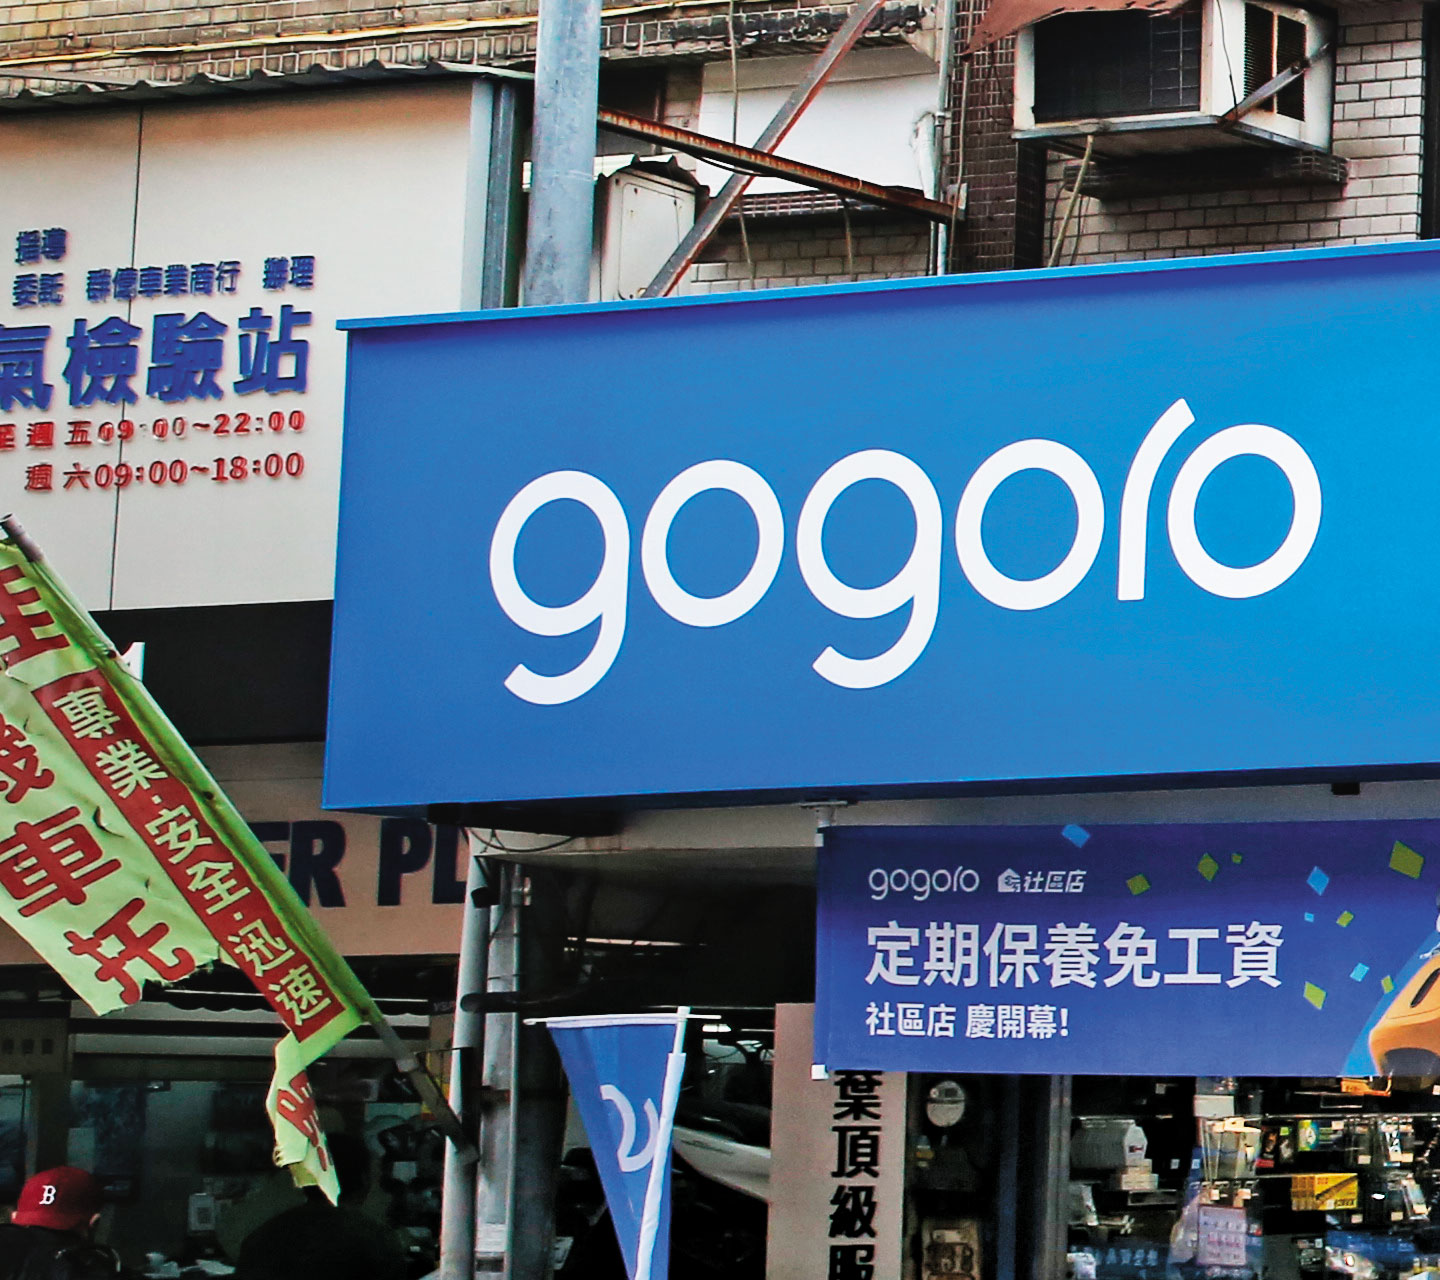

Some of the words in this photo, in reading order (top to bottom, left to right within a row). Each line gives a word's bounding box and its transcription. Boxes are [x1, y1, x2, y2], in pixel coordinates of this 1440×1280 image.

[490, 398, 1322, 705] gogoro
[868, 866, 980, 901] gogoro
[1023, 869, 1087, 895] 社區店
[865, 922, 1284, 991] 定期保養免工資
[865, 1002, 956, 1041] 社區店
[965, 1001, 1070, 1040] 慶開幕!
[39, 1184, 57, 1206] B
